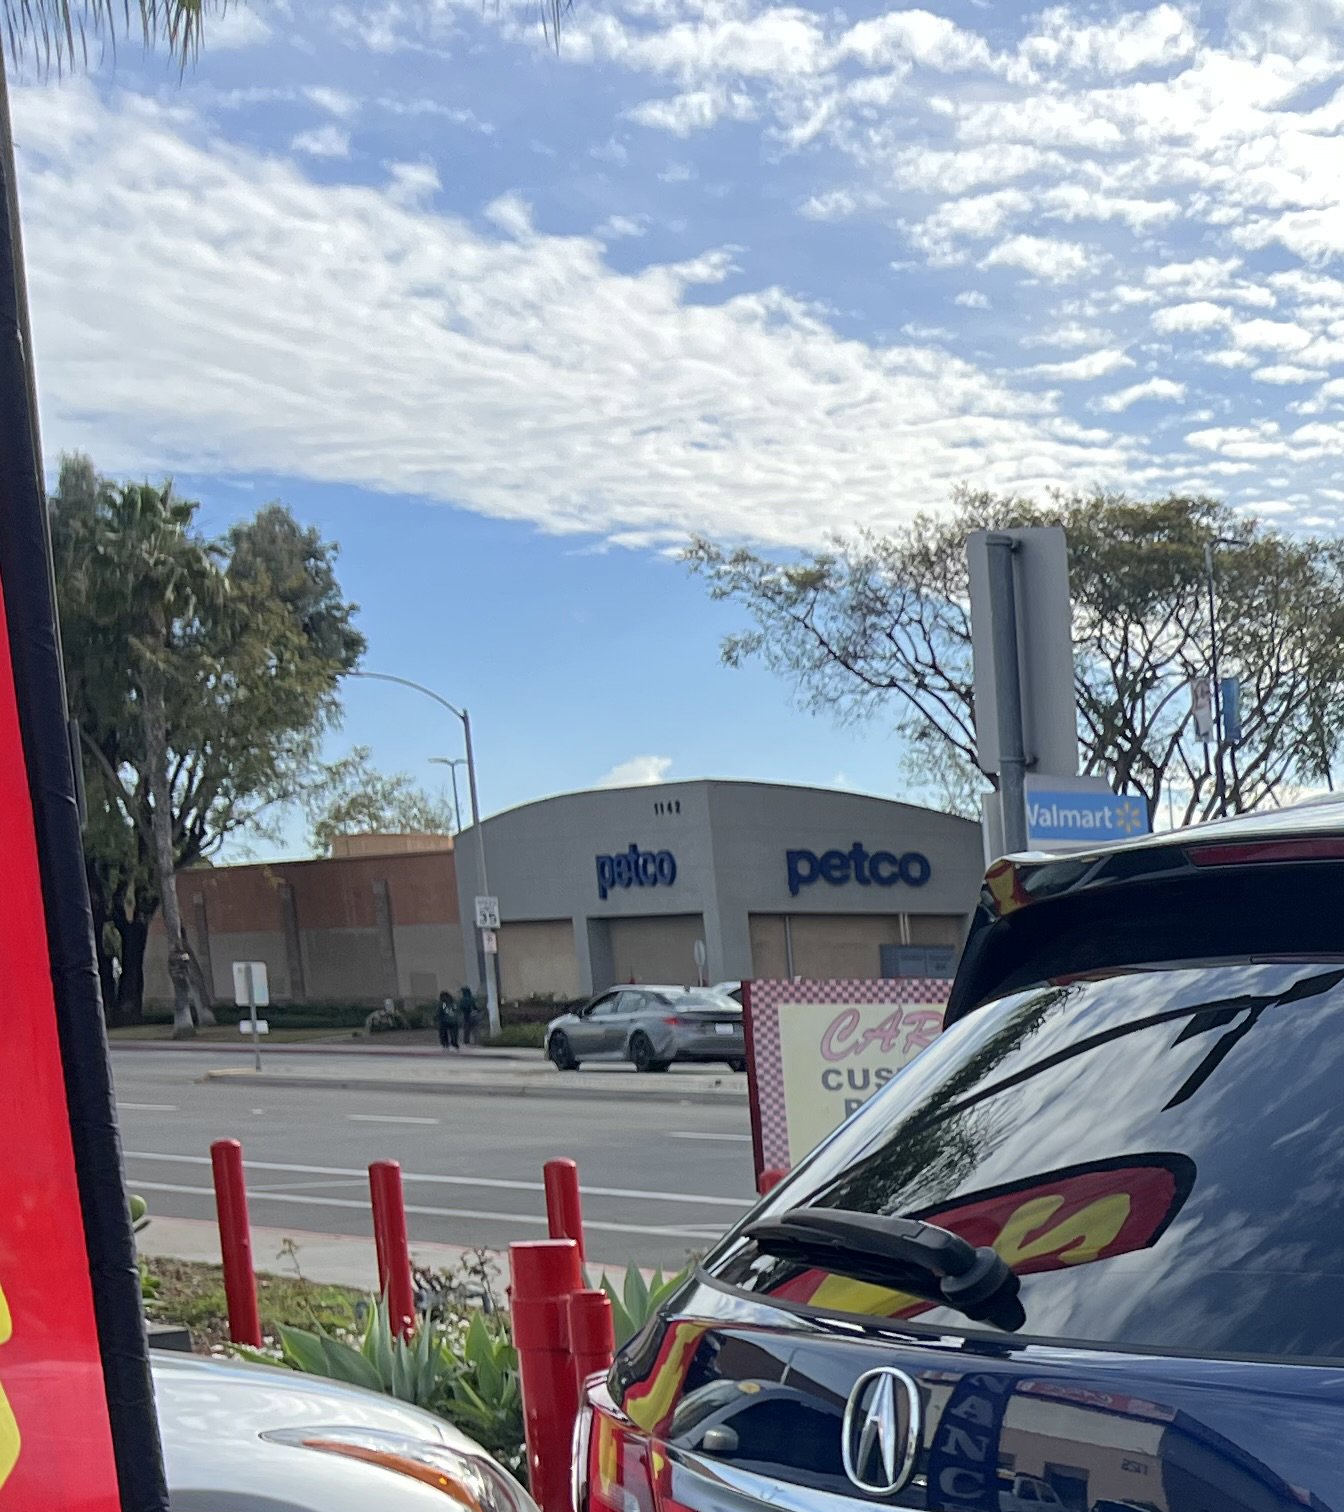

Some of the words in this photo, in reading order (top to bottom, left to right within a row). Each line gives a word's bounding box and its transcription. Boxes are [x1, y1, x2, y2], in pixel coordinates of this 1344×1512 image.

[654, 800, 681, 816] 1142
[596, 842, 677, 900] petco
[786, 841, 932, 897] petco
[821, 1067, 904, 1091] CUS
